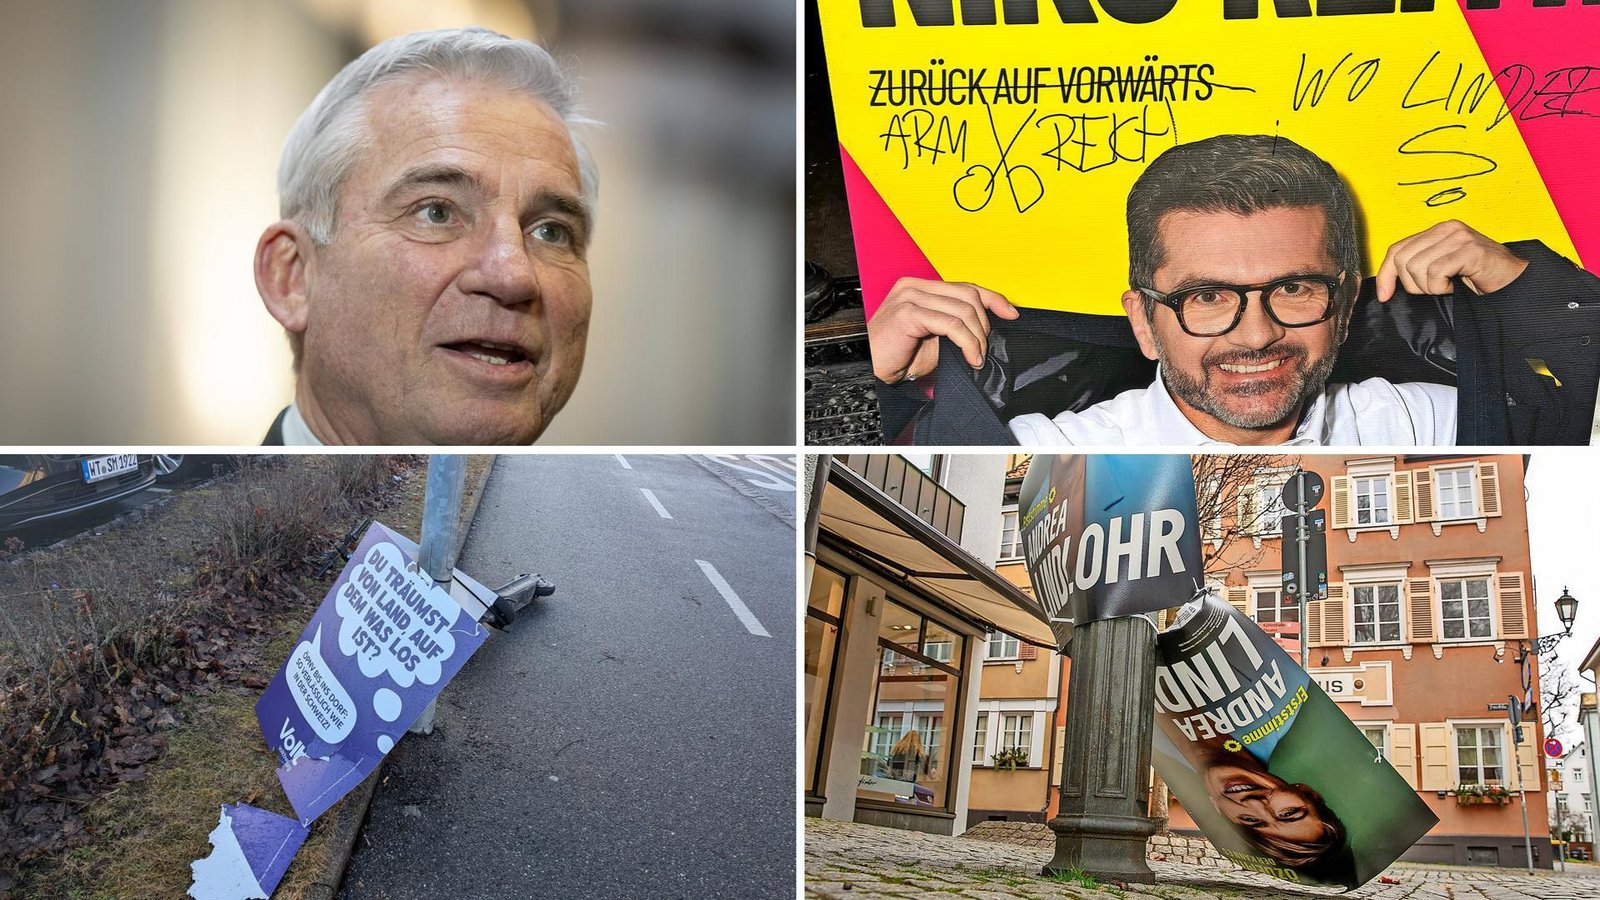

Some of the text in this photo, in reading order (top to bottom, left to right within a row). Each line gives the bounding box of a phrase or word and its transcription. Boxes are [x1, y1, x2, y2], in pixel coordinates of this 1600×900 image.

[869, 54, 1215, 106] ZURÜCK AUF VORWÄRTS
[1293, 52, 1381, 111] WO
[879, 108, 967, 170] ARM
[107, 457, 119, 472] SM
[1027, 497, 1068, 569] ANDREA
[357, 567, 445, 660] VON LAND, AUF
[368, 549, 451, 634] DU TRÄUMST
[343, 583, 421, 672] DEM WAS LOS
[351, 626, 382, 661] IST?
[293, 672, 332, 731] IN DER SCHWEIZ!
[295, 657, 345, 730] SO VERLÄSSLICH WIE
[303, 650, 349, 719] ÖPNV BIS INS DORF:
[1172, 658, 1287, 742] ANDREA
[1242, 685, 1309, 745] Erststimme
